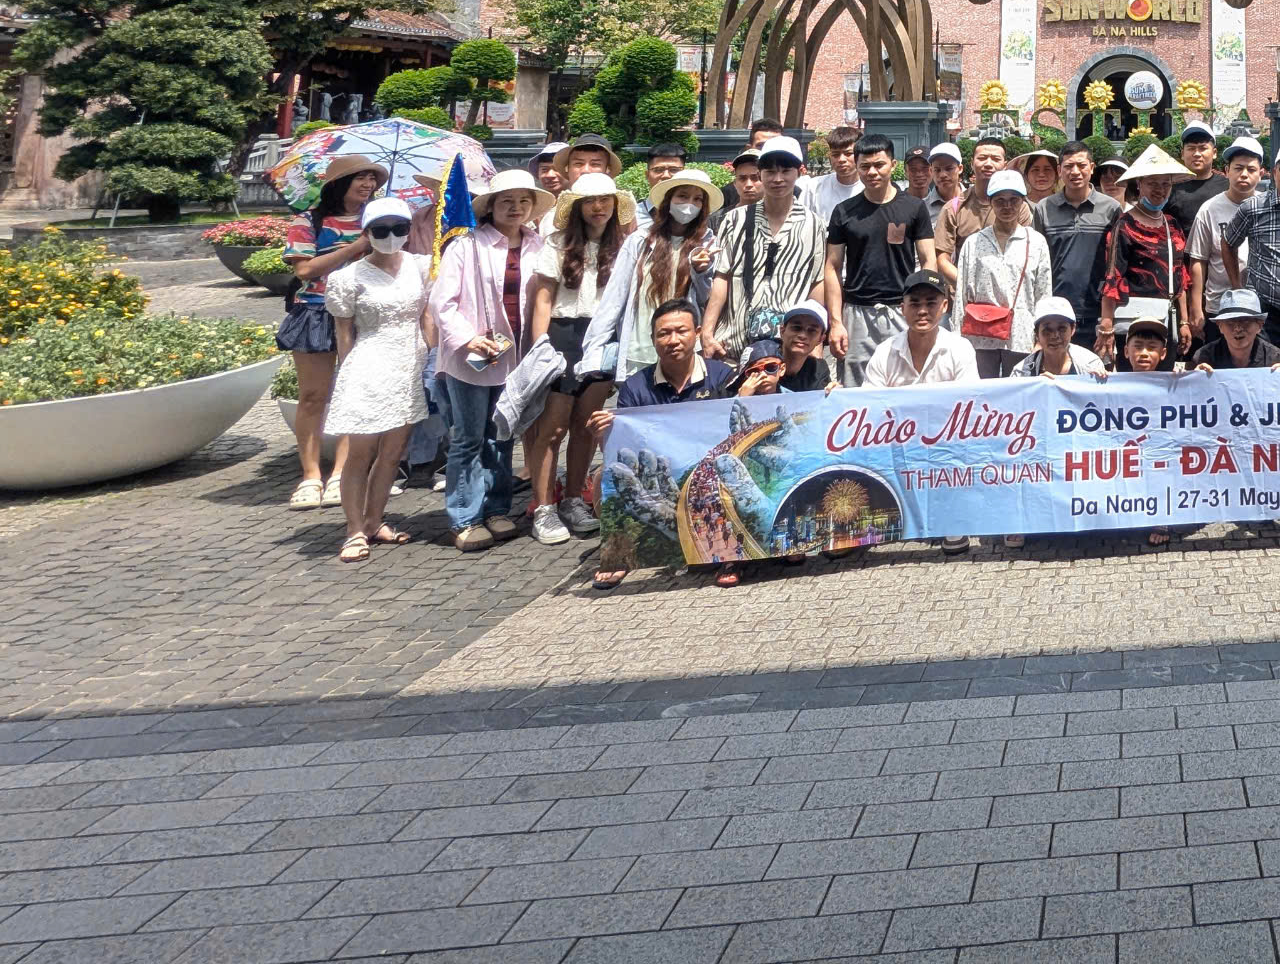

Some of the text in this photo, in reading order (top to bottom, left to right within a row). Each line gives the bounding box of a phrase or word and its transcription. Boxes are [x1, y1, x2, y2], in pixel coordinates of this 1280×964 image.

[1093, 26, 1158, 36] BA NA HILLS
[826, 401, 1036, 454] Chào Mừng
[1160, 397, 1219, 429] PHÚ
[1229, 403, 1249, 427] &
[1064, 433, 1152, 483] HUẾ
[1180, 435, 1239, 476] ĐÀ
[902, 463, 1054, 490] THAM QUAN
[1071, 496, 1098, 516] Da
[1107, 494, 1158, 516] Nang
[1177, 489, 1231, 510] 27-31
[1240, 487, 1280, 510] May
